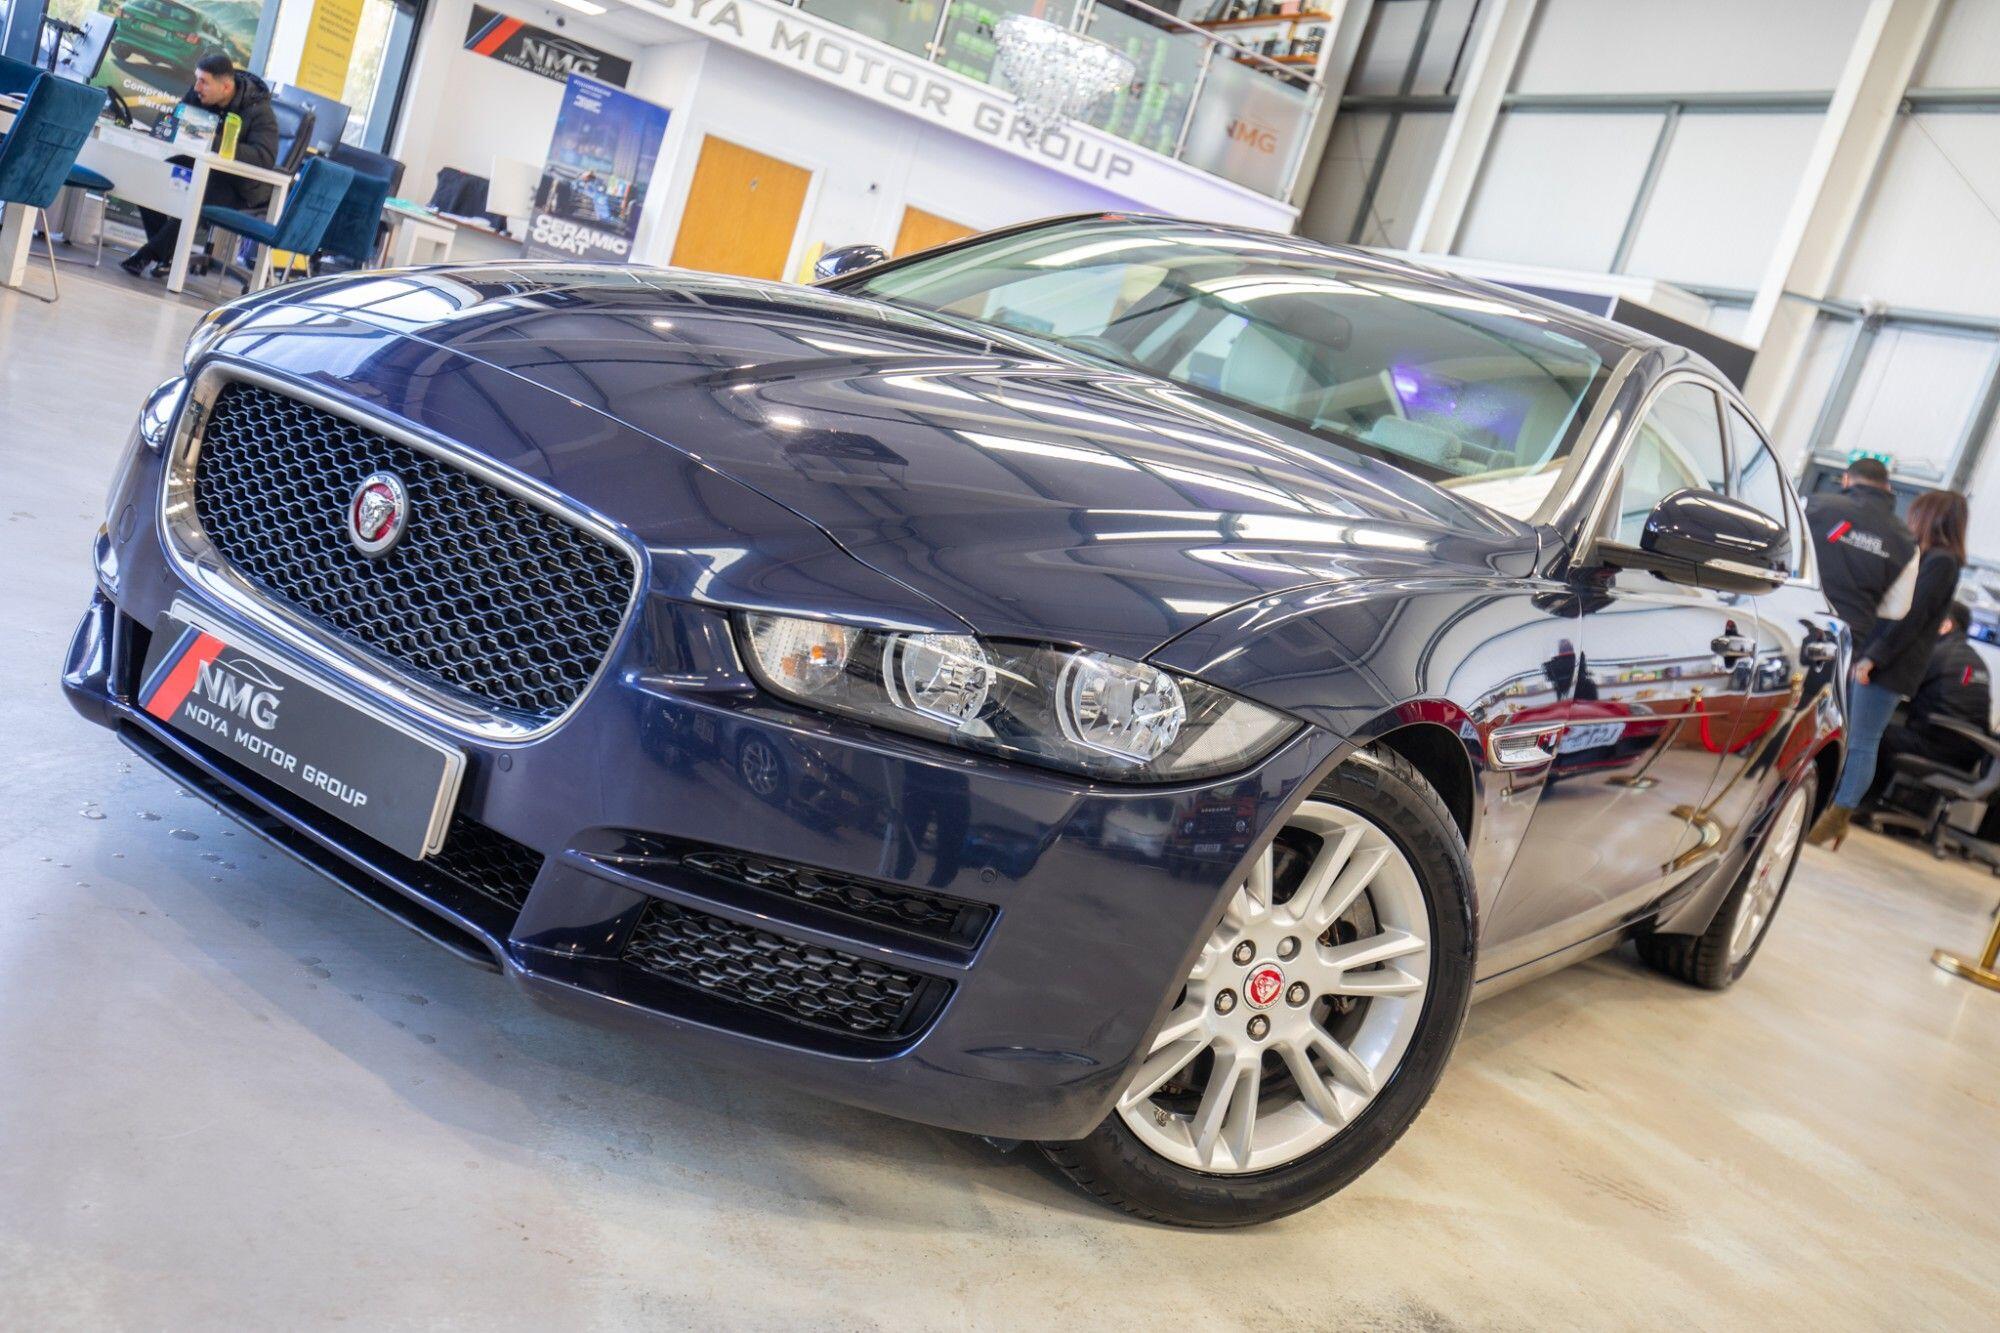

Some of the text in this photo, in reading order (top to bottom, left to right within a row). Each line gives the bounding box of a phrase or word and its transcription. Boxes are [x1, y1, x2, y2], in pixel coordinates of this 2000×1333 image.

[520, 37, 598, 79] NMG
[770, 19, 953, 117] MOTOR
[973, 101, 1135, 180] GROUP
[532, 227, 585, 256] COAT
[536, 213, 628, 256] CERAMIC
[192, 658, 281, 731] NMG
[184, 701, 368, 808] NOYA MOTOR GROUP
